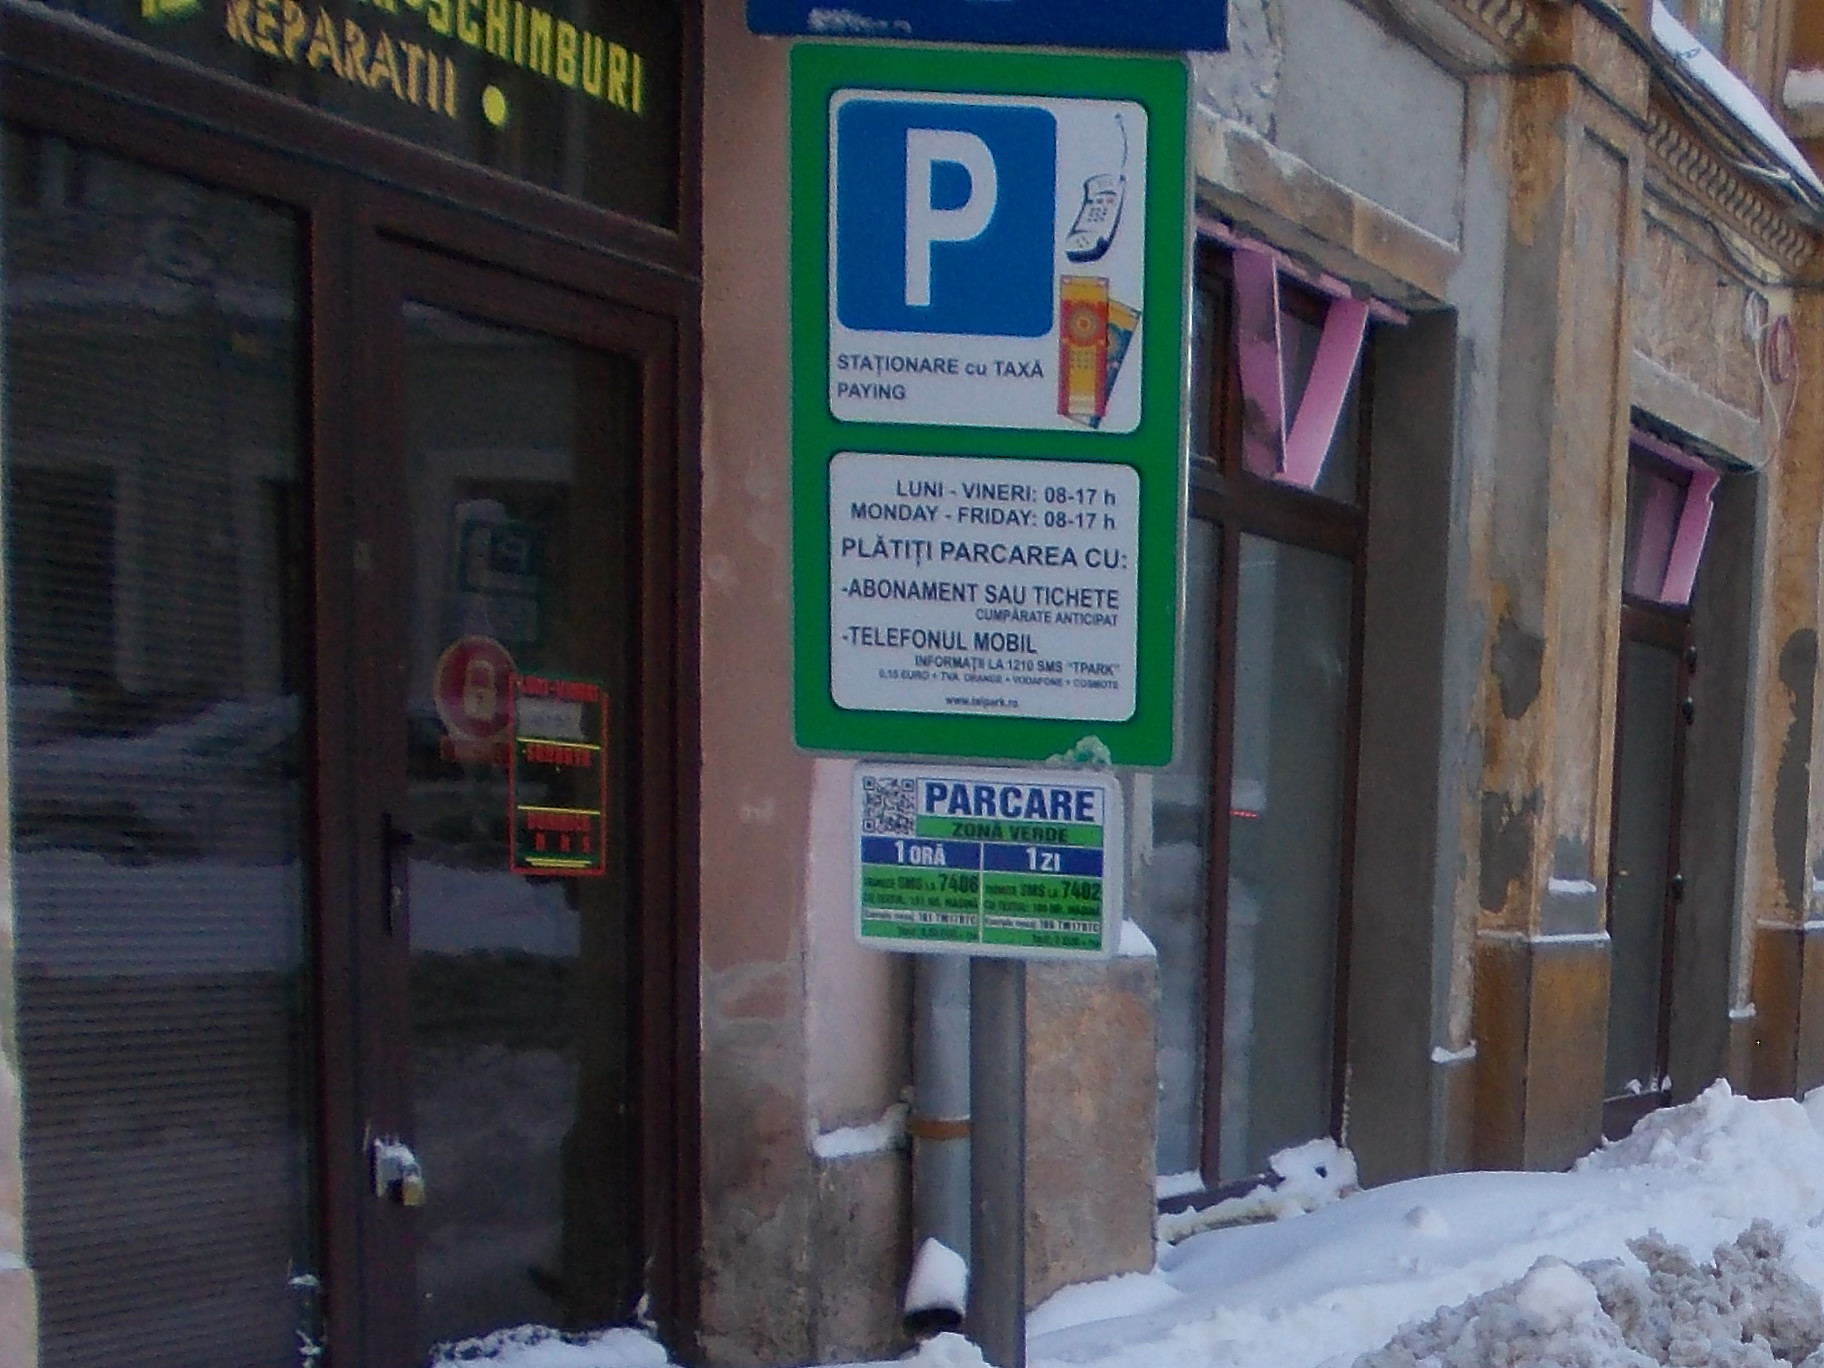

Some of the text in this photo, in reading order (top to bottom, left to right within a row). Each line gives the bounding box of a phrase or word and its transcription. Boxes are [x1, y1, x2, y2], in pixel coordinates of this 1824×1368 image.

[905, 128, 998, 306] P
[965, 363, 988, 377] cu
[838, 382, 906, 400] PAYING
[896, 481, 944, 499] LUNI
[962, 484, 1037, 502] VINERI:
[1044, 487, 1097, 505] 08-17
[1104, 490, 1116, 507] h
[851, 503, 939, 522] MONDAY
[958, 508, 1037, 527] FRIDAY:
[1044, 512, 1097, 530] 08-17
[1104, 515, 1116, 531] h
[940, 541, 1078, 567] PARCAREA
[1086, 548, 1128, 569] CU:
[985, 584, 1027, 604] SAU
[1032, 586, 1119, 610] TICHETE
[1055, 612, 1119, 627] ANTICIPAT
[974, 632, 1038, 654] MOBIL
[988, 659, 1004, 670] LA
[1008, 659, 1034, 672] 1210
[1037, 660, 1063, 673] SMS
[925, 782, 1095, 822] PARCARE
[1009, 825, 1069, 842] VERDE
[894, 840, 904, 863] 1
[1026, 847, 1060, 872] 1 ZI
